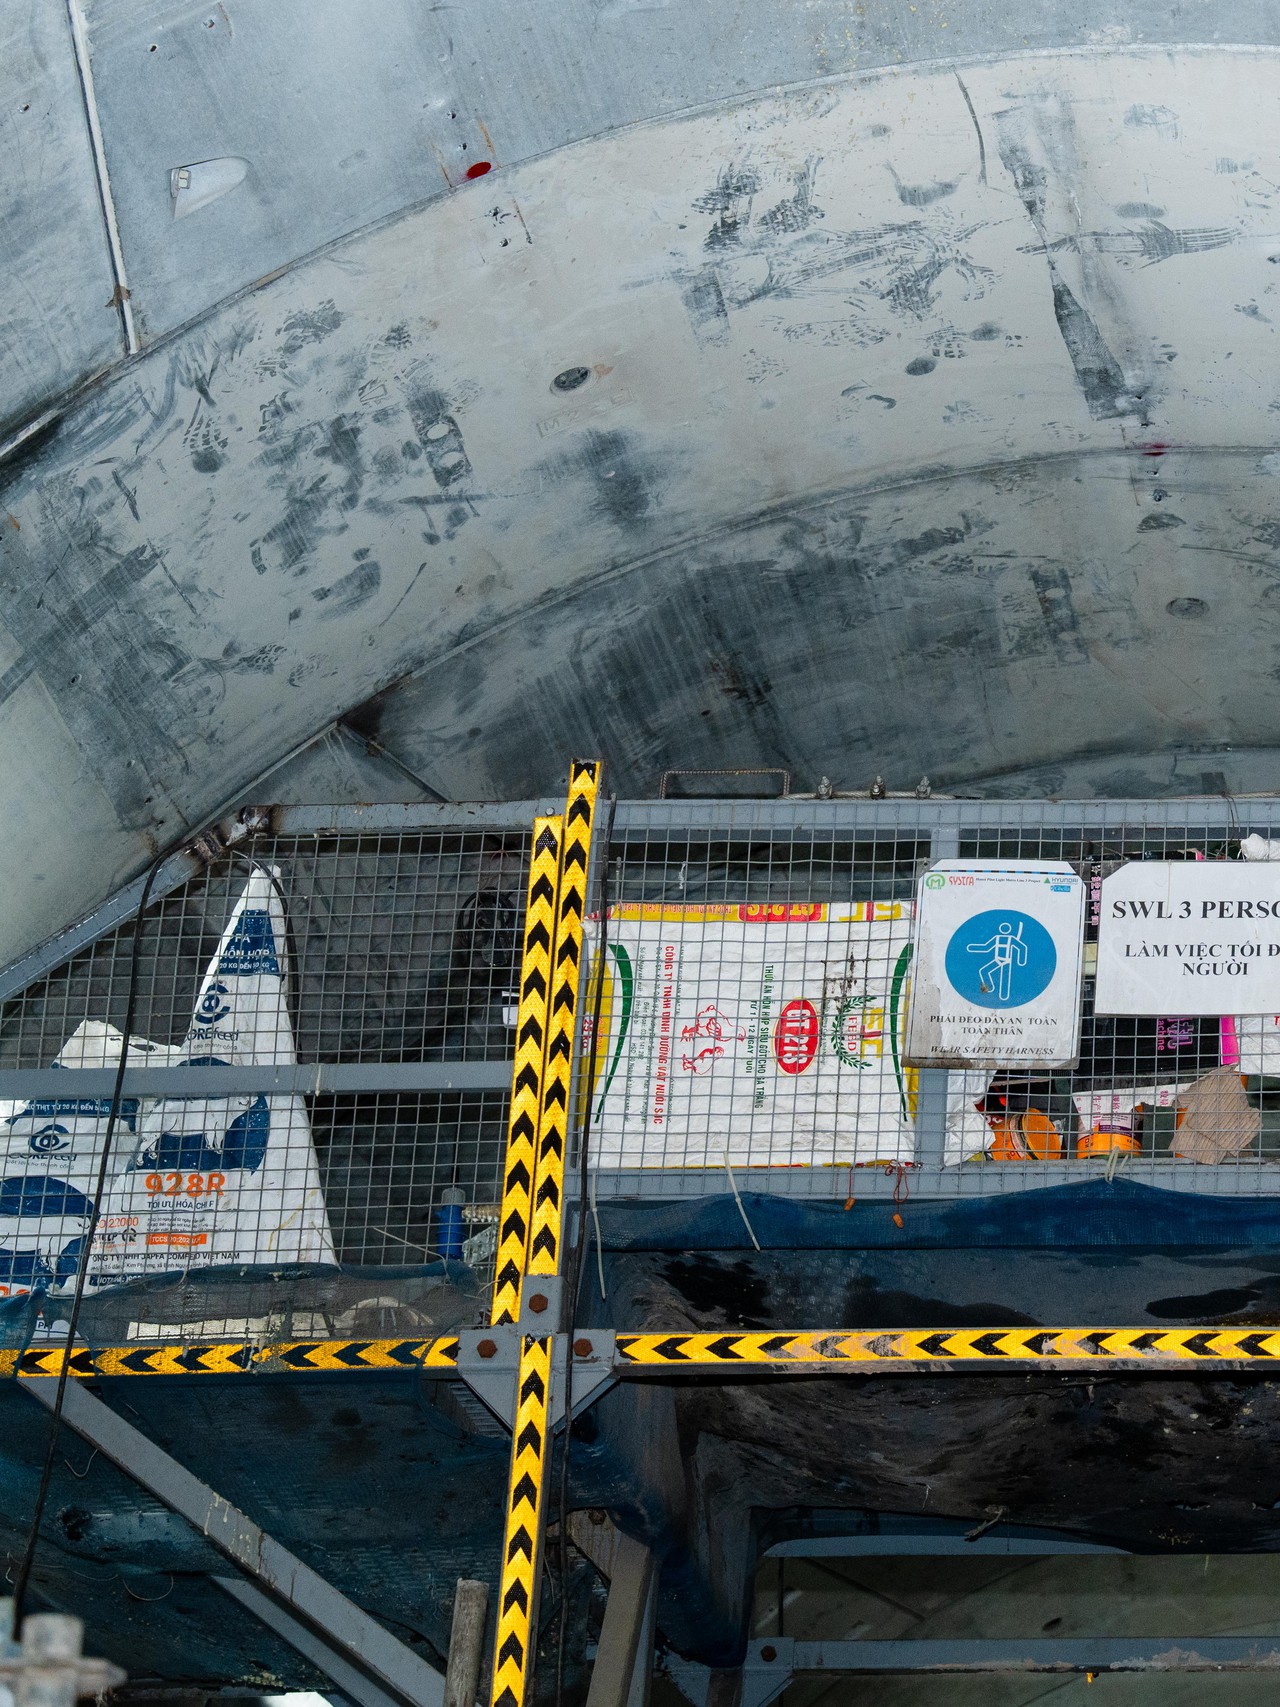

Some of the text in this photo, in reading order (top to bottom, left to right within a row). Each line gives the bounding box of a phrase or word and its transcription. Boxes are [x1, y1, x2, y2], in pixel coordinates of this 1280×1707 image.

[1112, 900, 1173, 919] SWL
[1178, 900, 1192, 919] 3
[664, 946, 677, 970] CÔNG
[1124, 940, 1169, 958] LÀM
[1174, 941, 1223, 961] VIỆC
[1227, 940, 1262, 957] TỐI
[1182, 958, 1249, 976] NGƯỜI
[662, 985, 673, 1009] TNHH
[748, 1024, 755, 1033] 12
[959, 1015, 981, 1024] ĐEO
[1027, 1016, 1058, 1026] TOÀN
[782, 1009, 811, 1064] GT 21S
[847, 1016, 858, 1051] FEED
[994, 1026, 1024, 1035] THÂN
[930, 1045, 1055, 1055] WEAR SAFETY HARNESS
[758, 1059, 767, 1074] CHO
[145, 1172, 225, 1197] 928R
